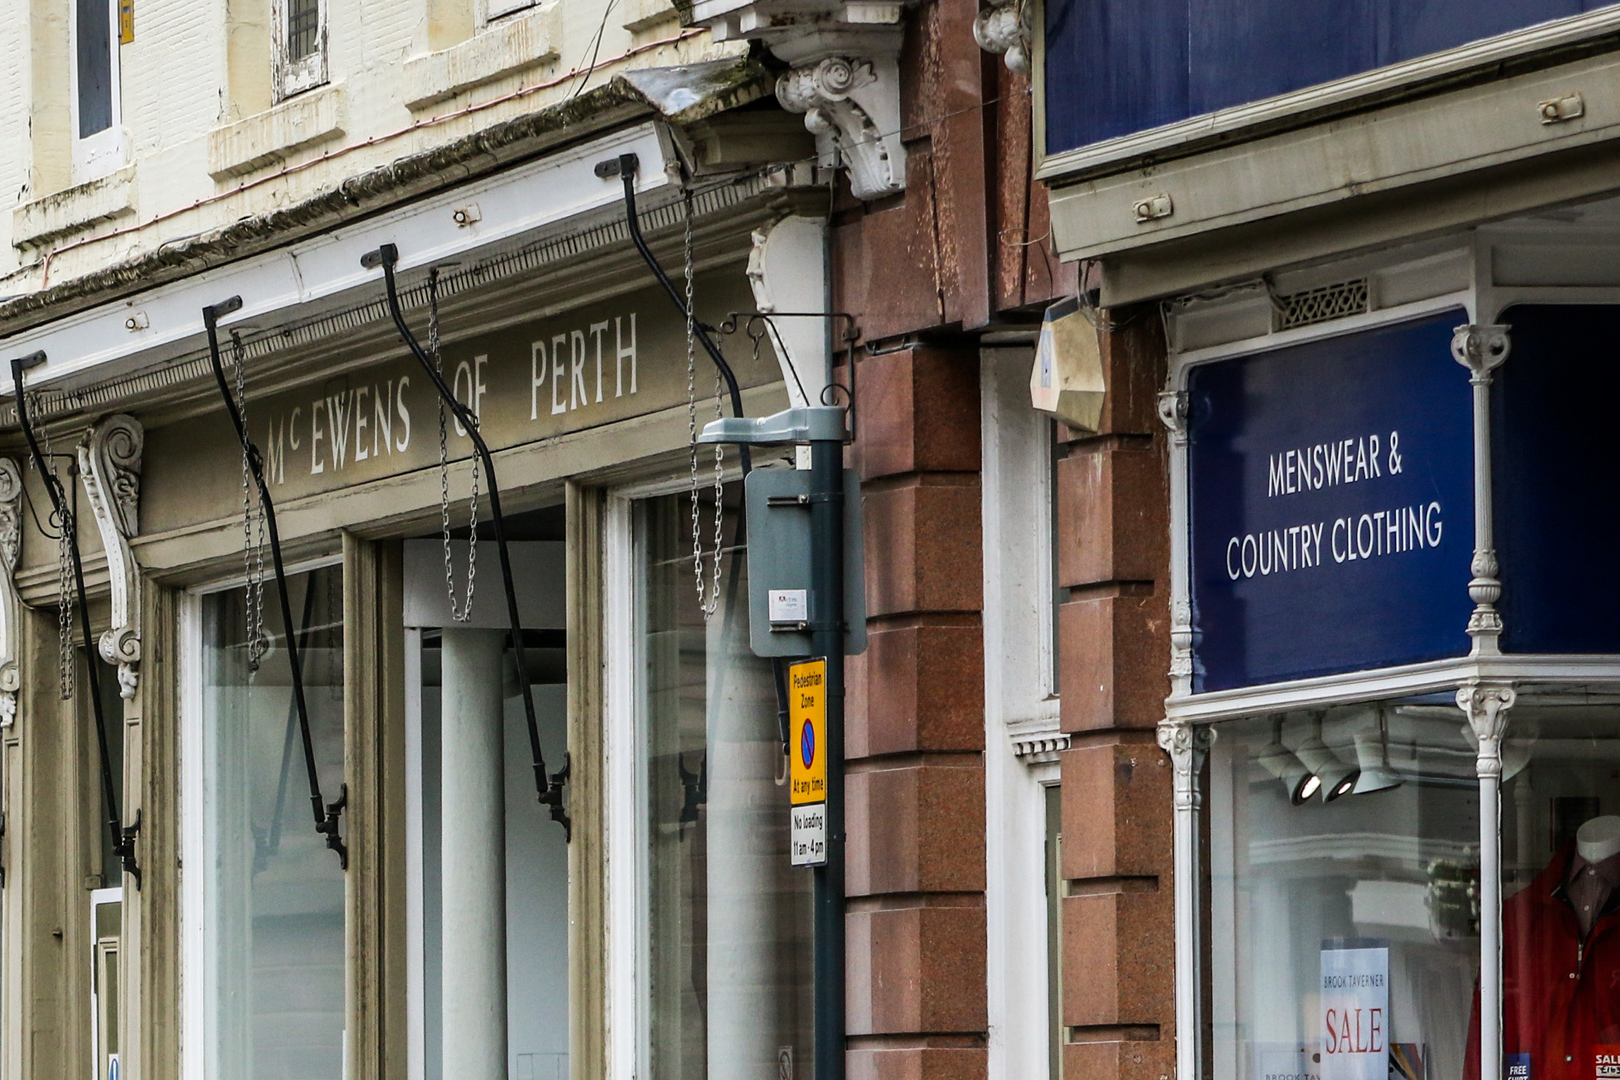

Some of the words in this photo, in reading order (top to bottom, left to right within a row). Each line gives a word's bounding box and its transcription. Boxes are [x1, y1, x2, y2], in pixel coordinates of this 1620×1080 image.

[453, 354, 488, 437] OF
[531, 312, 637, 421] PERTH
[1268, 434, 1381, 497] MENSWEAR
[1388, 430, 1402, 475] &
[1226, 522, 1324, 580] COUNTRY
[1331, 501, 1443, 563] CLOTHING
[793, 671, 822, 689] Pedestrian
[801, 693, 814, 709] Zone
[793, 779, 799, 793] At
[801, 781, 810, 795] any
[812, 777, 823, 791] time
[794, 814, 802, 830] No
[803, 812, 822, 830] loading
[1324, 976, 1346, 989] BROOK
[1349, 974, 1384, 987] TAVERNER
[1326, 1008, 1383, 1054] SALE
[1509, 1066, 1527, 1075] FREE
